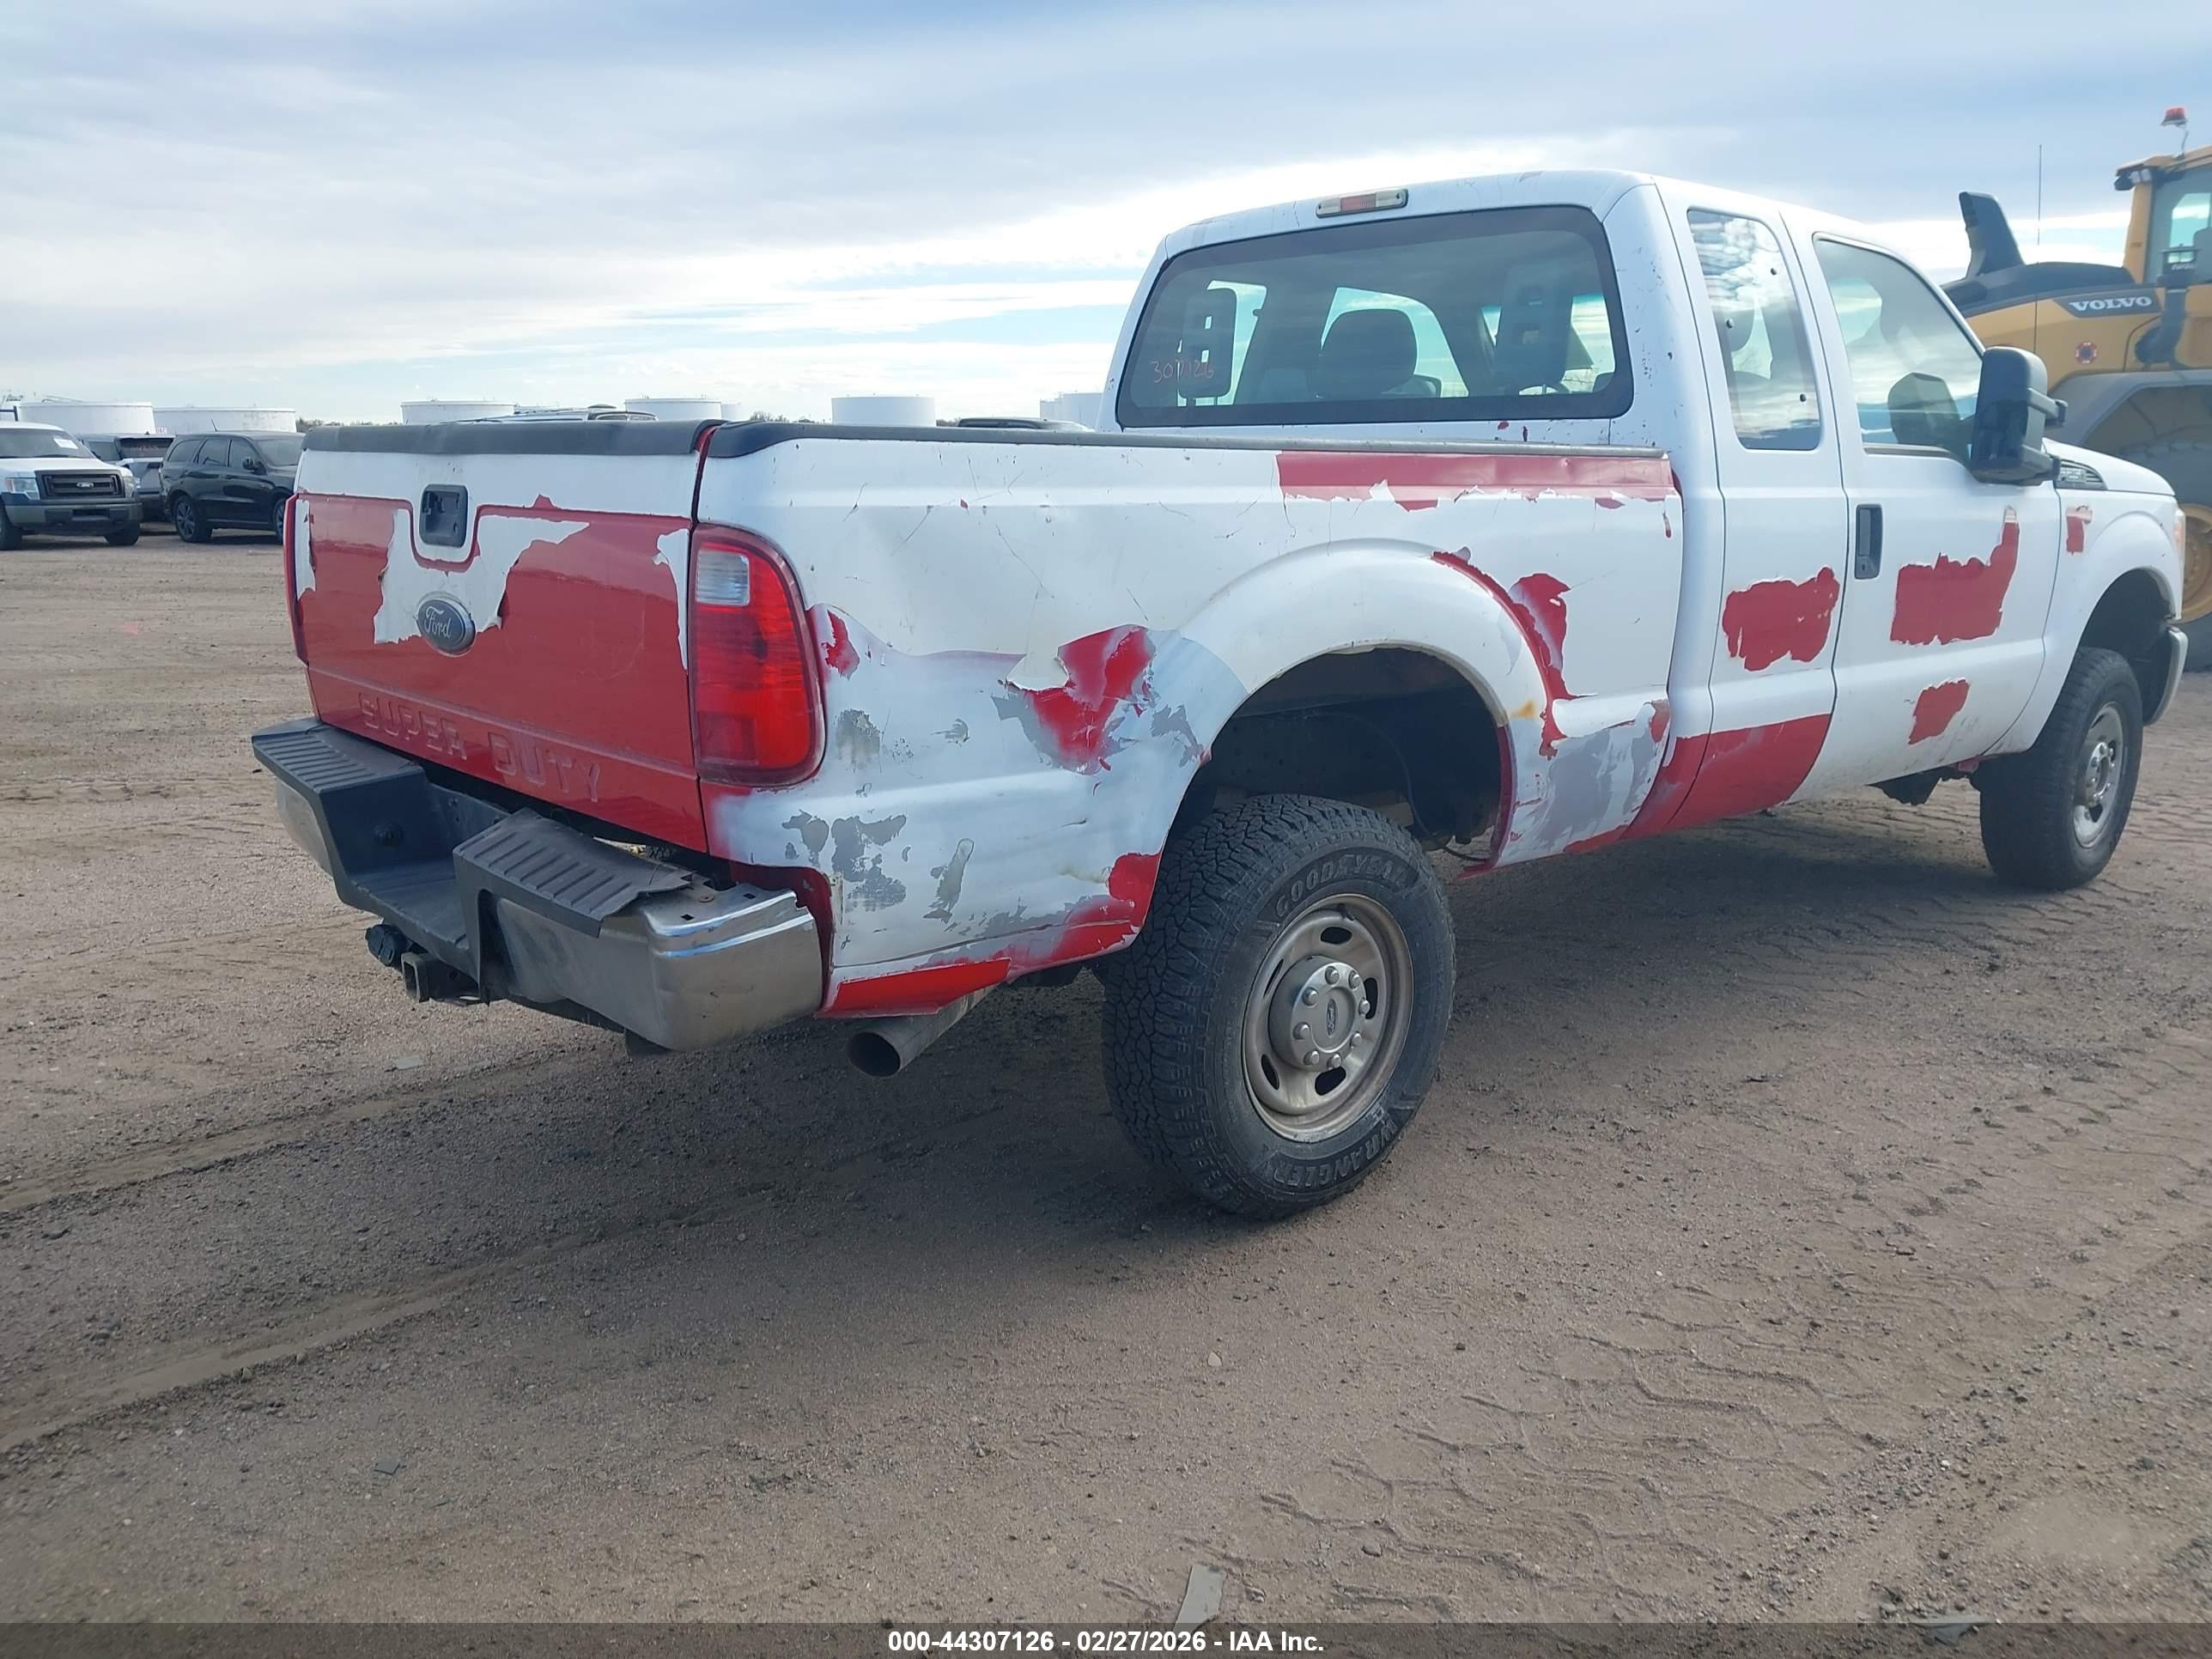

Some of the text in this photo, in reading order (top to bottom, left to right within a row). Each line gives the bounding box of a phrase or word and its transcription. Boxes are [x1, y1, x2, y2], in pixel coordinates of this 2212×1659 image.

[2069, 295, 2153, 312] VOLVO
[423, 605, 452, 640] Ford
[357, 691, 601, 804] SUPER DUTY
[1273, 1115, 1399, 1187] WRANGLER
